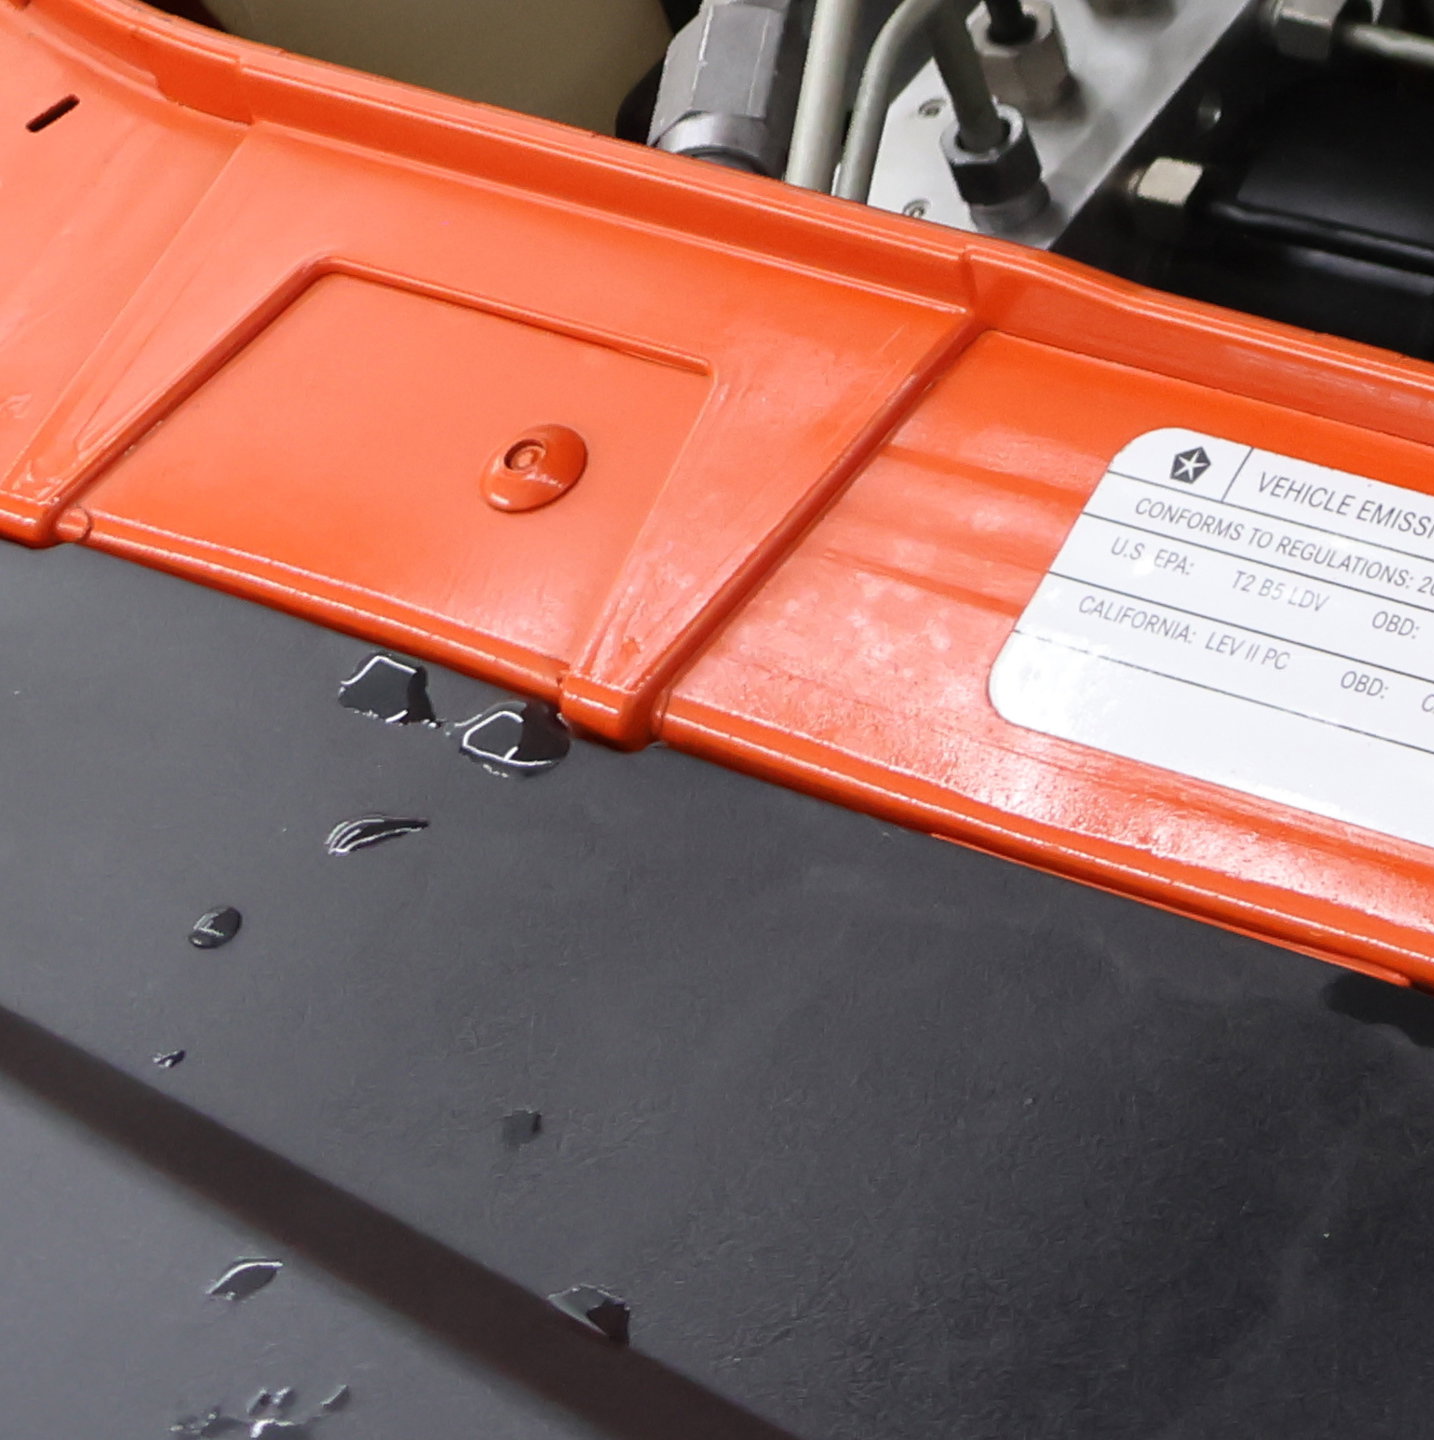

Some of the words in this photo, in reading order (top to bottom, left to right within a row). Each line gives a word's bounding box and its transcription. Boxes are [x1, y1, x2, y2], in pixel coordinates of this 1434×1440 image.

[1258, 471, 1356, 516] VEHICLE
[1135, 497, 1245, 541] CONFORMS
[1248, 527, 1274, 549] TO
[1274, 535, 1414, 589] REGULATIONS:
[1153, 548, 1195, 576] EPA:
[1232, 569, 1257, 593] T2
[1371, 610, 1420, 640] OBD:
[1078, 595, 1197, 645] CALIFORNIA:
[1204, 631, 1246, 657] LEV
[1260, 647, 1291, 671] PC
[1340, 670, 1389, 700] OBD:
